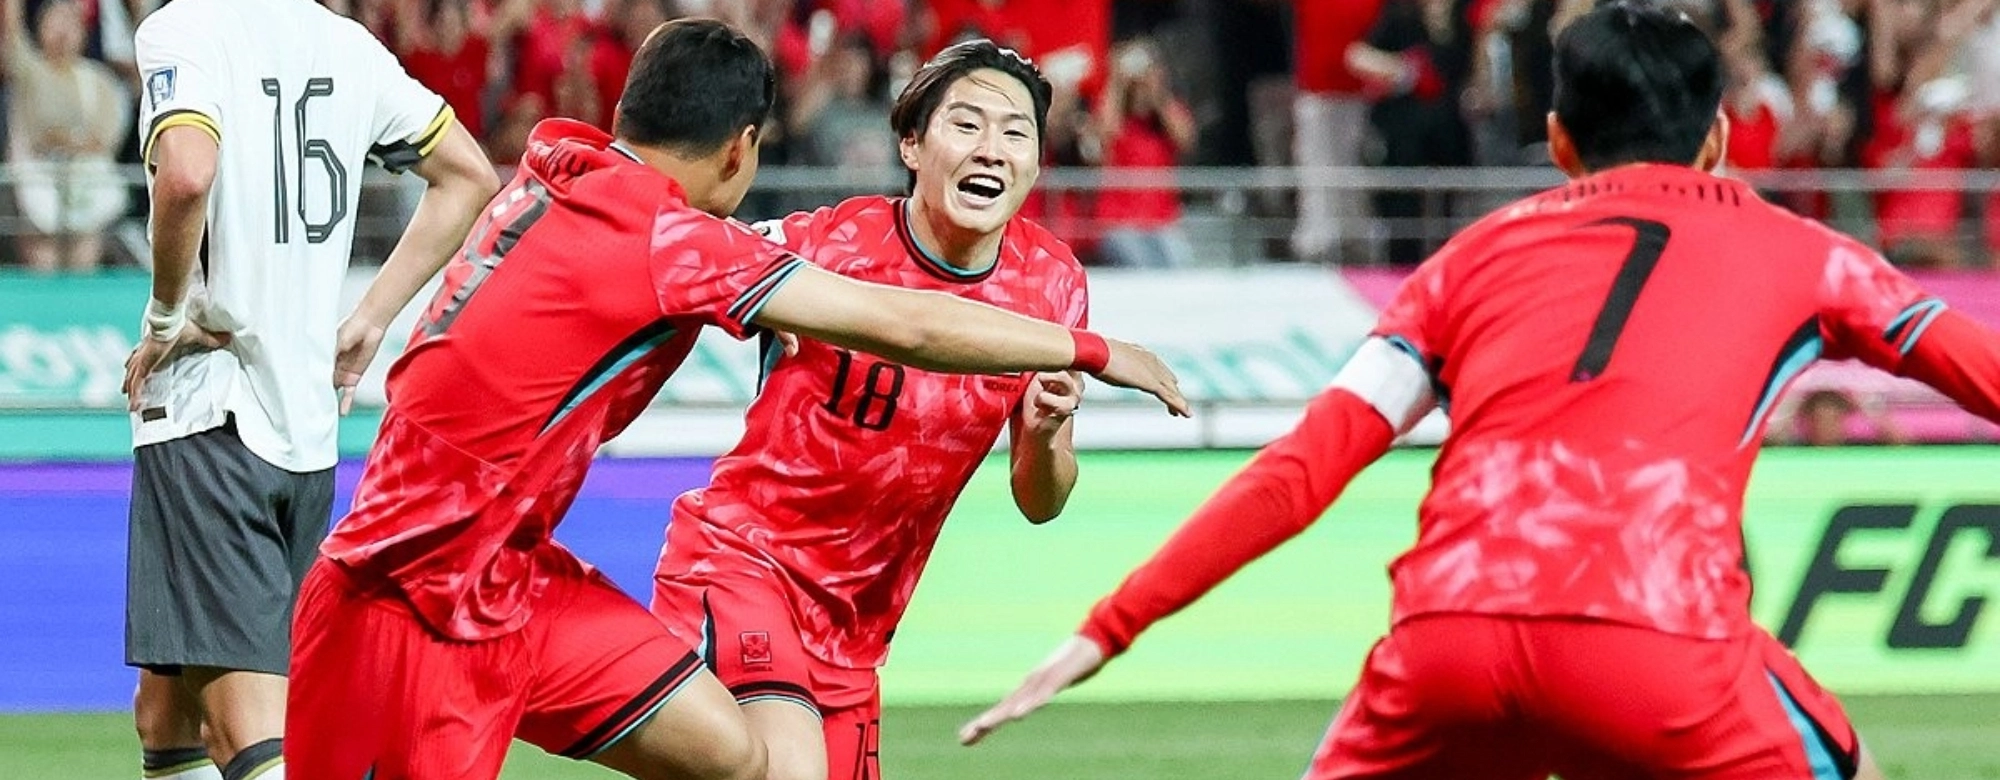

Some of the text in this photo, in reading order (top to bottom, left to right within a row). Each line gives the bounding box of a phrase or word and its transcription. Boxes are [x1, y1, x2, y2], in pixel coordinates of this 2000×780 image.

[261, 77, 347, 243] 16
[1569, 216, 1671, 383] 7
[818, 350, 905, 431] 18
[1778, 504, 2000, 648] FC
